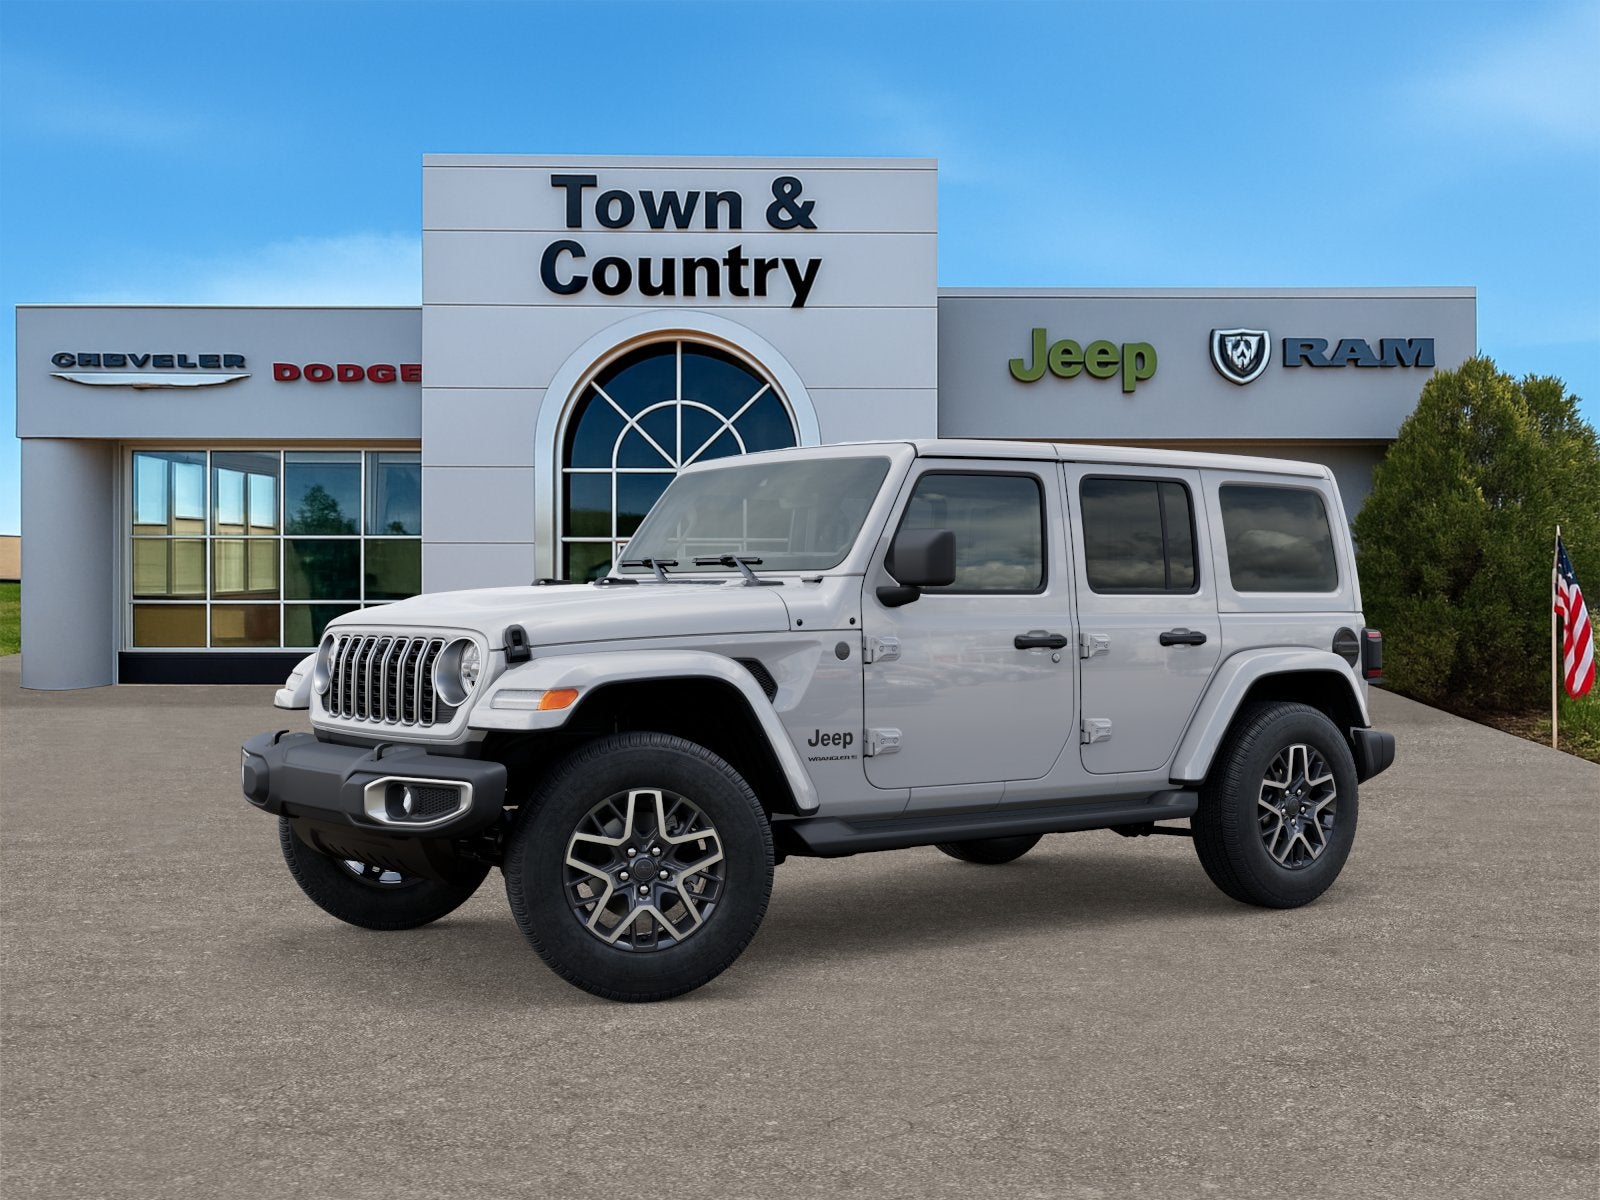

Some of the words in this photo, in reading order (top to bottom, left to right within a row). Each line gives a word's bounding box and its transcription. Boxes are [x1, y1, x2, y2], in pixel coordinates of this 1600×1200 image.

[550, 174, 742, 229] Town
[765, 176, 818, 230] &
[540, 239, 822, 308] Country
[273, 363, 422, 383] DODGE
[1009, 328, 1157, 393] Jeep
[1282, 337, 1436, 368] RAM
[807, 729, 854, 749] Jeep
